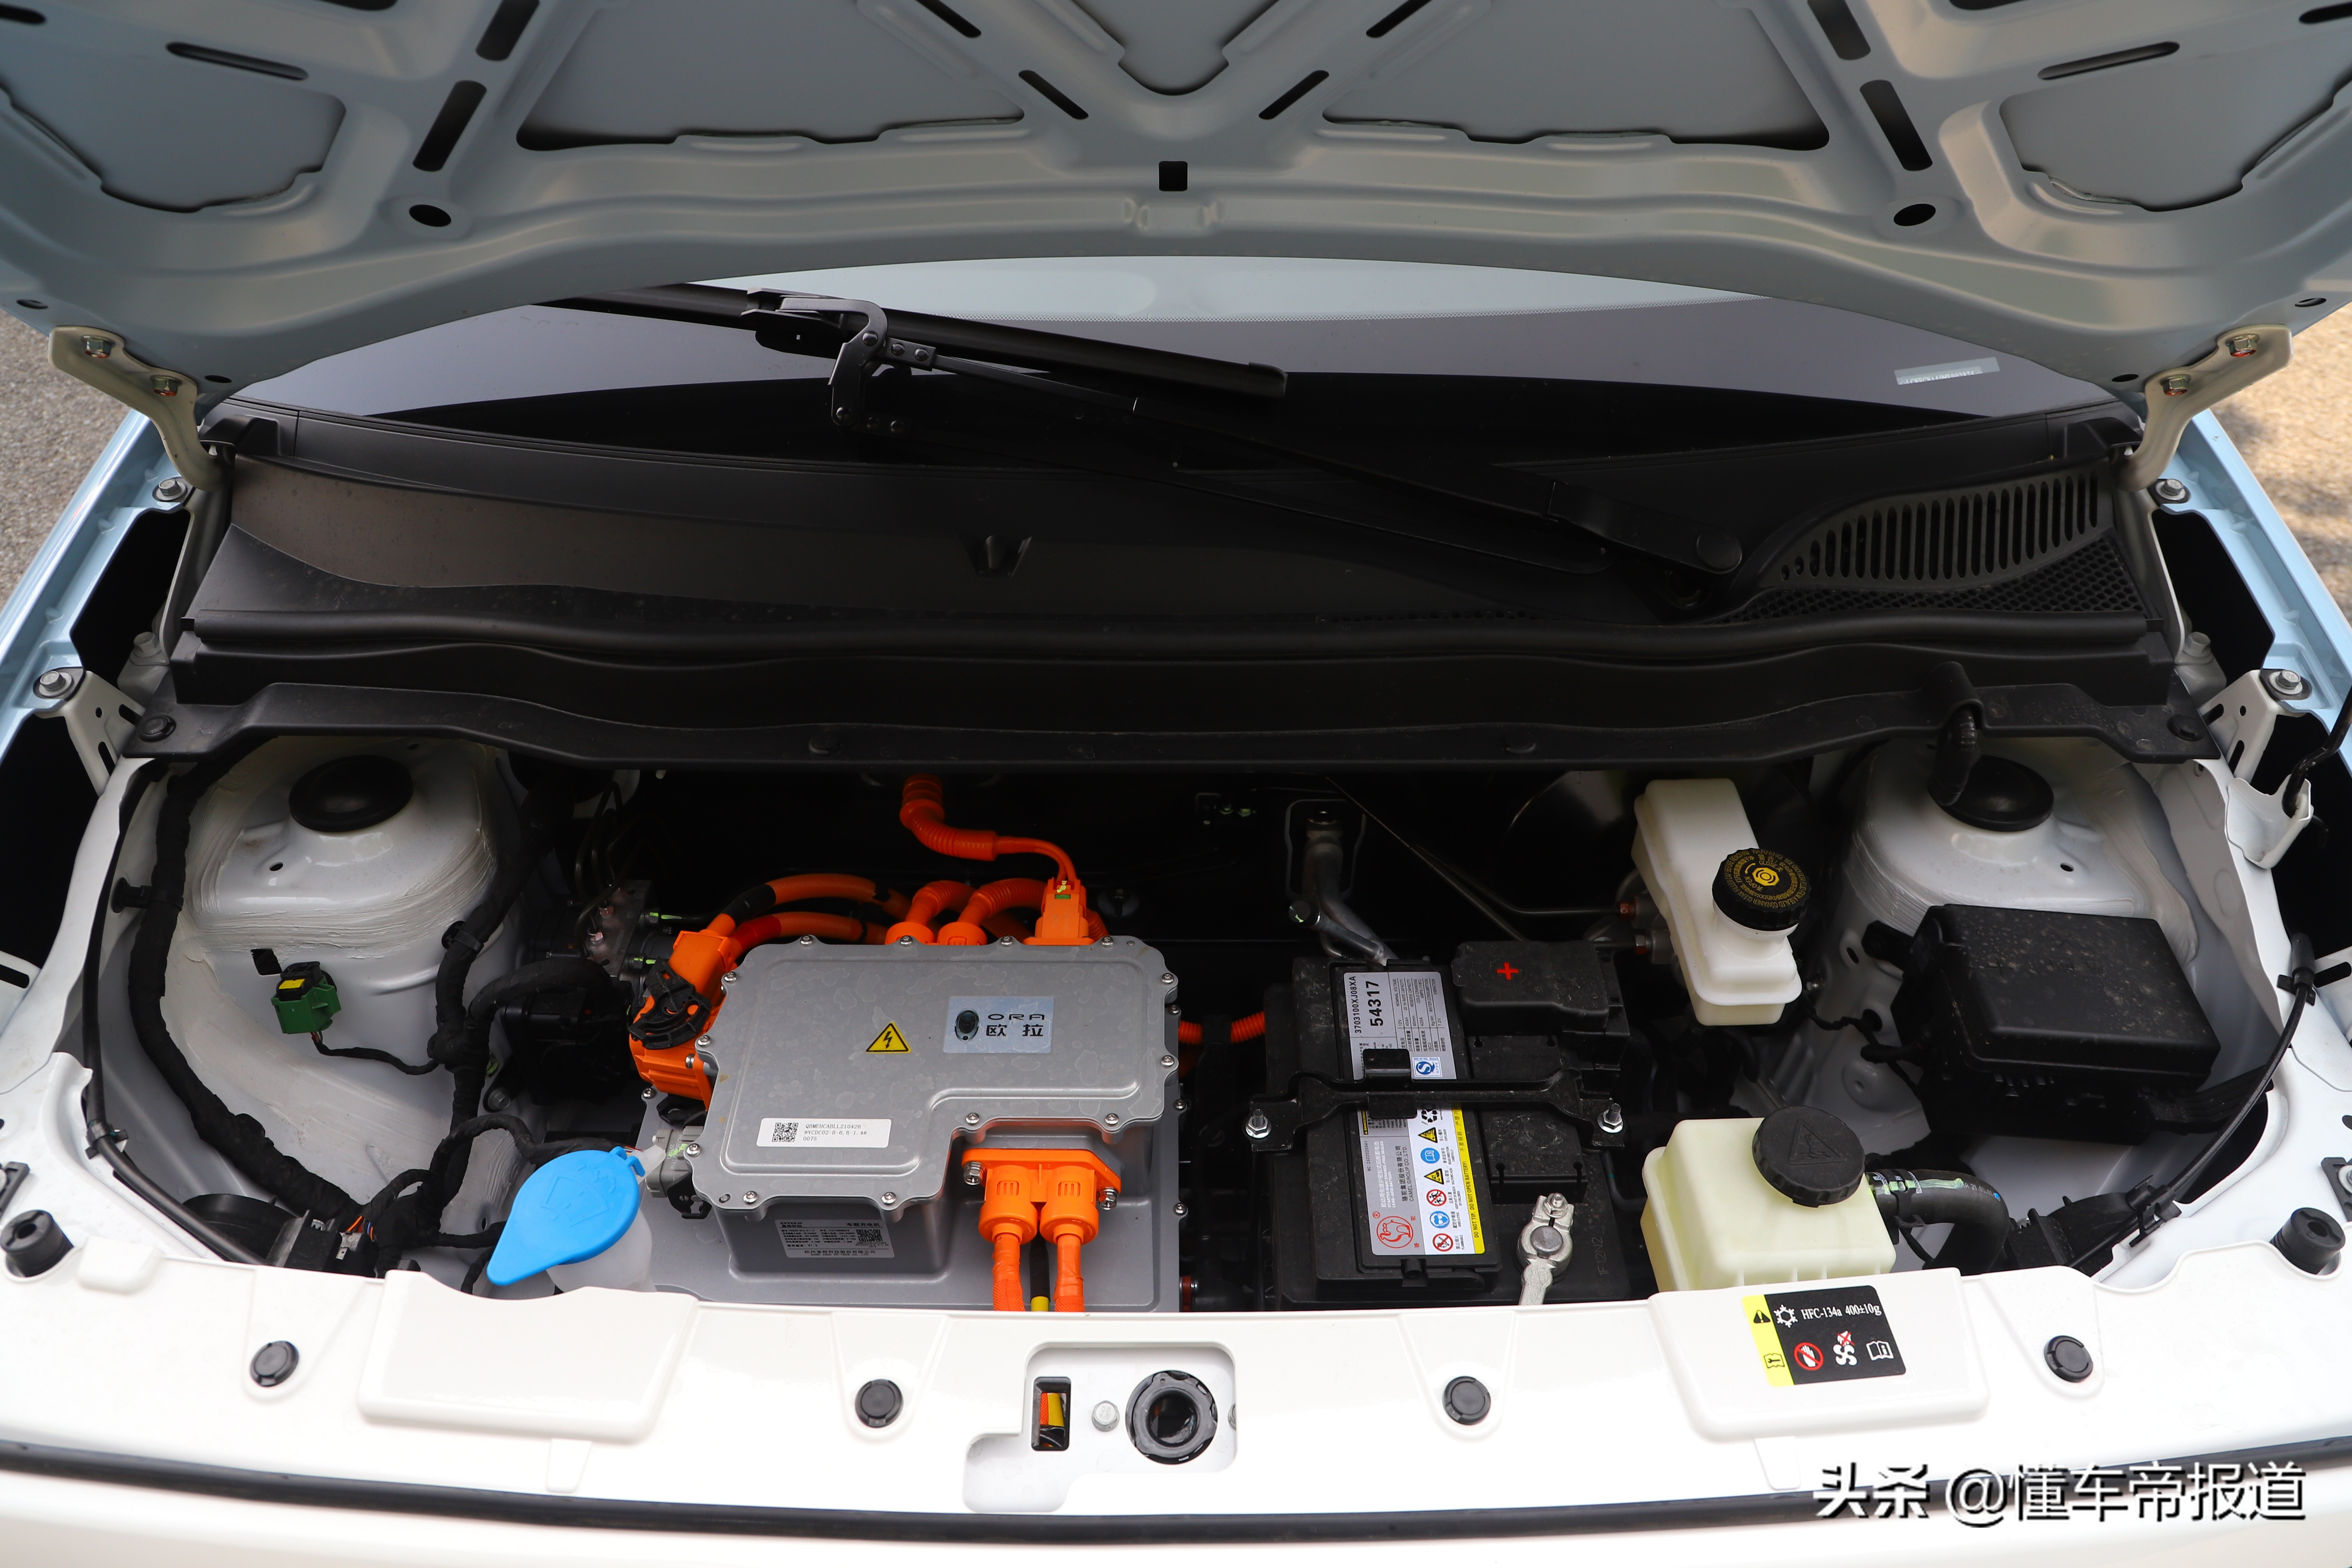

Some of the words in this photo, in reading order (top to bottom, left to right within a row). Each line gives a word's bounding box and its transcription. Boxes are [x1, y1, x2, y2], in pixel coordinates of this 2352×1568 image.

[1752, 849, 1783, 859] WARNING
[1738, 891, 1753, 902] CLEAN
[1349, 976, 1361, 1034] 3703100XJ08XA
[1365, 980, 1384, 1027] 54317
[986, 1024, 1043, 1037] 欧拉
[1395, 1145, 1408, 1201] 骆驼集团股份有限公司
[1801, 1306, 1843, 1320] HFC-134a
[1845, 1303, 1882, 1317] 400±10g
